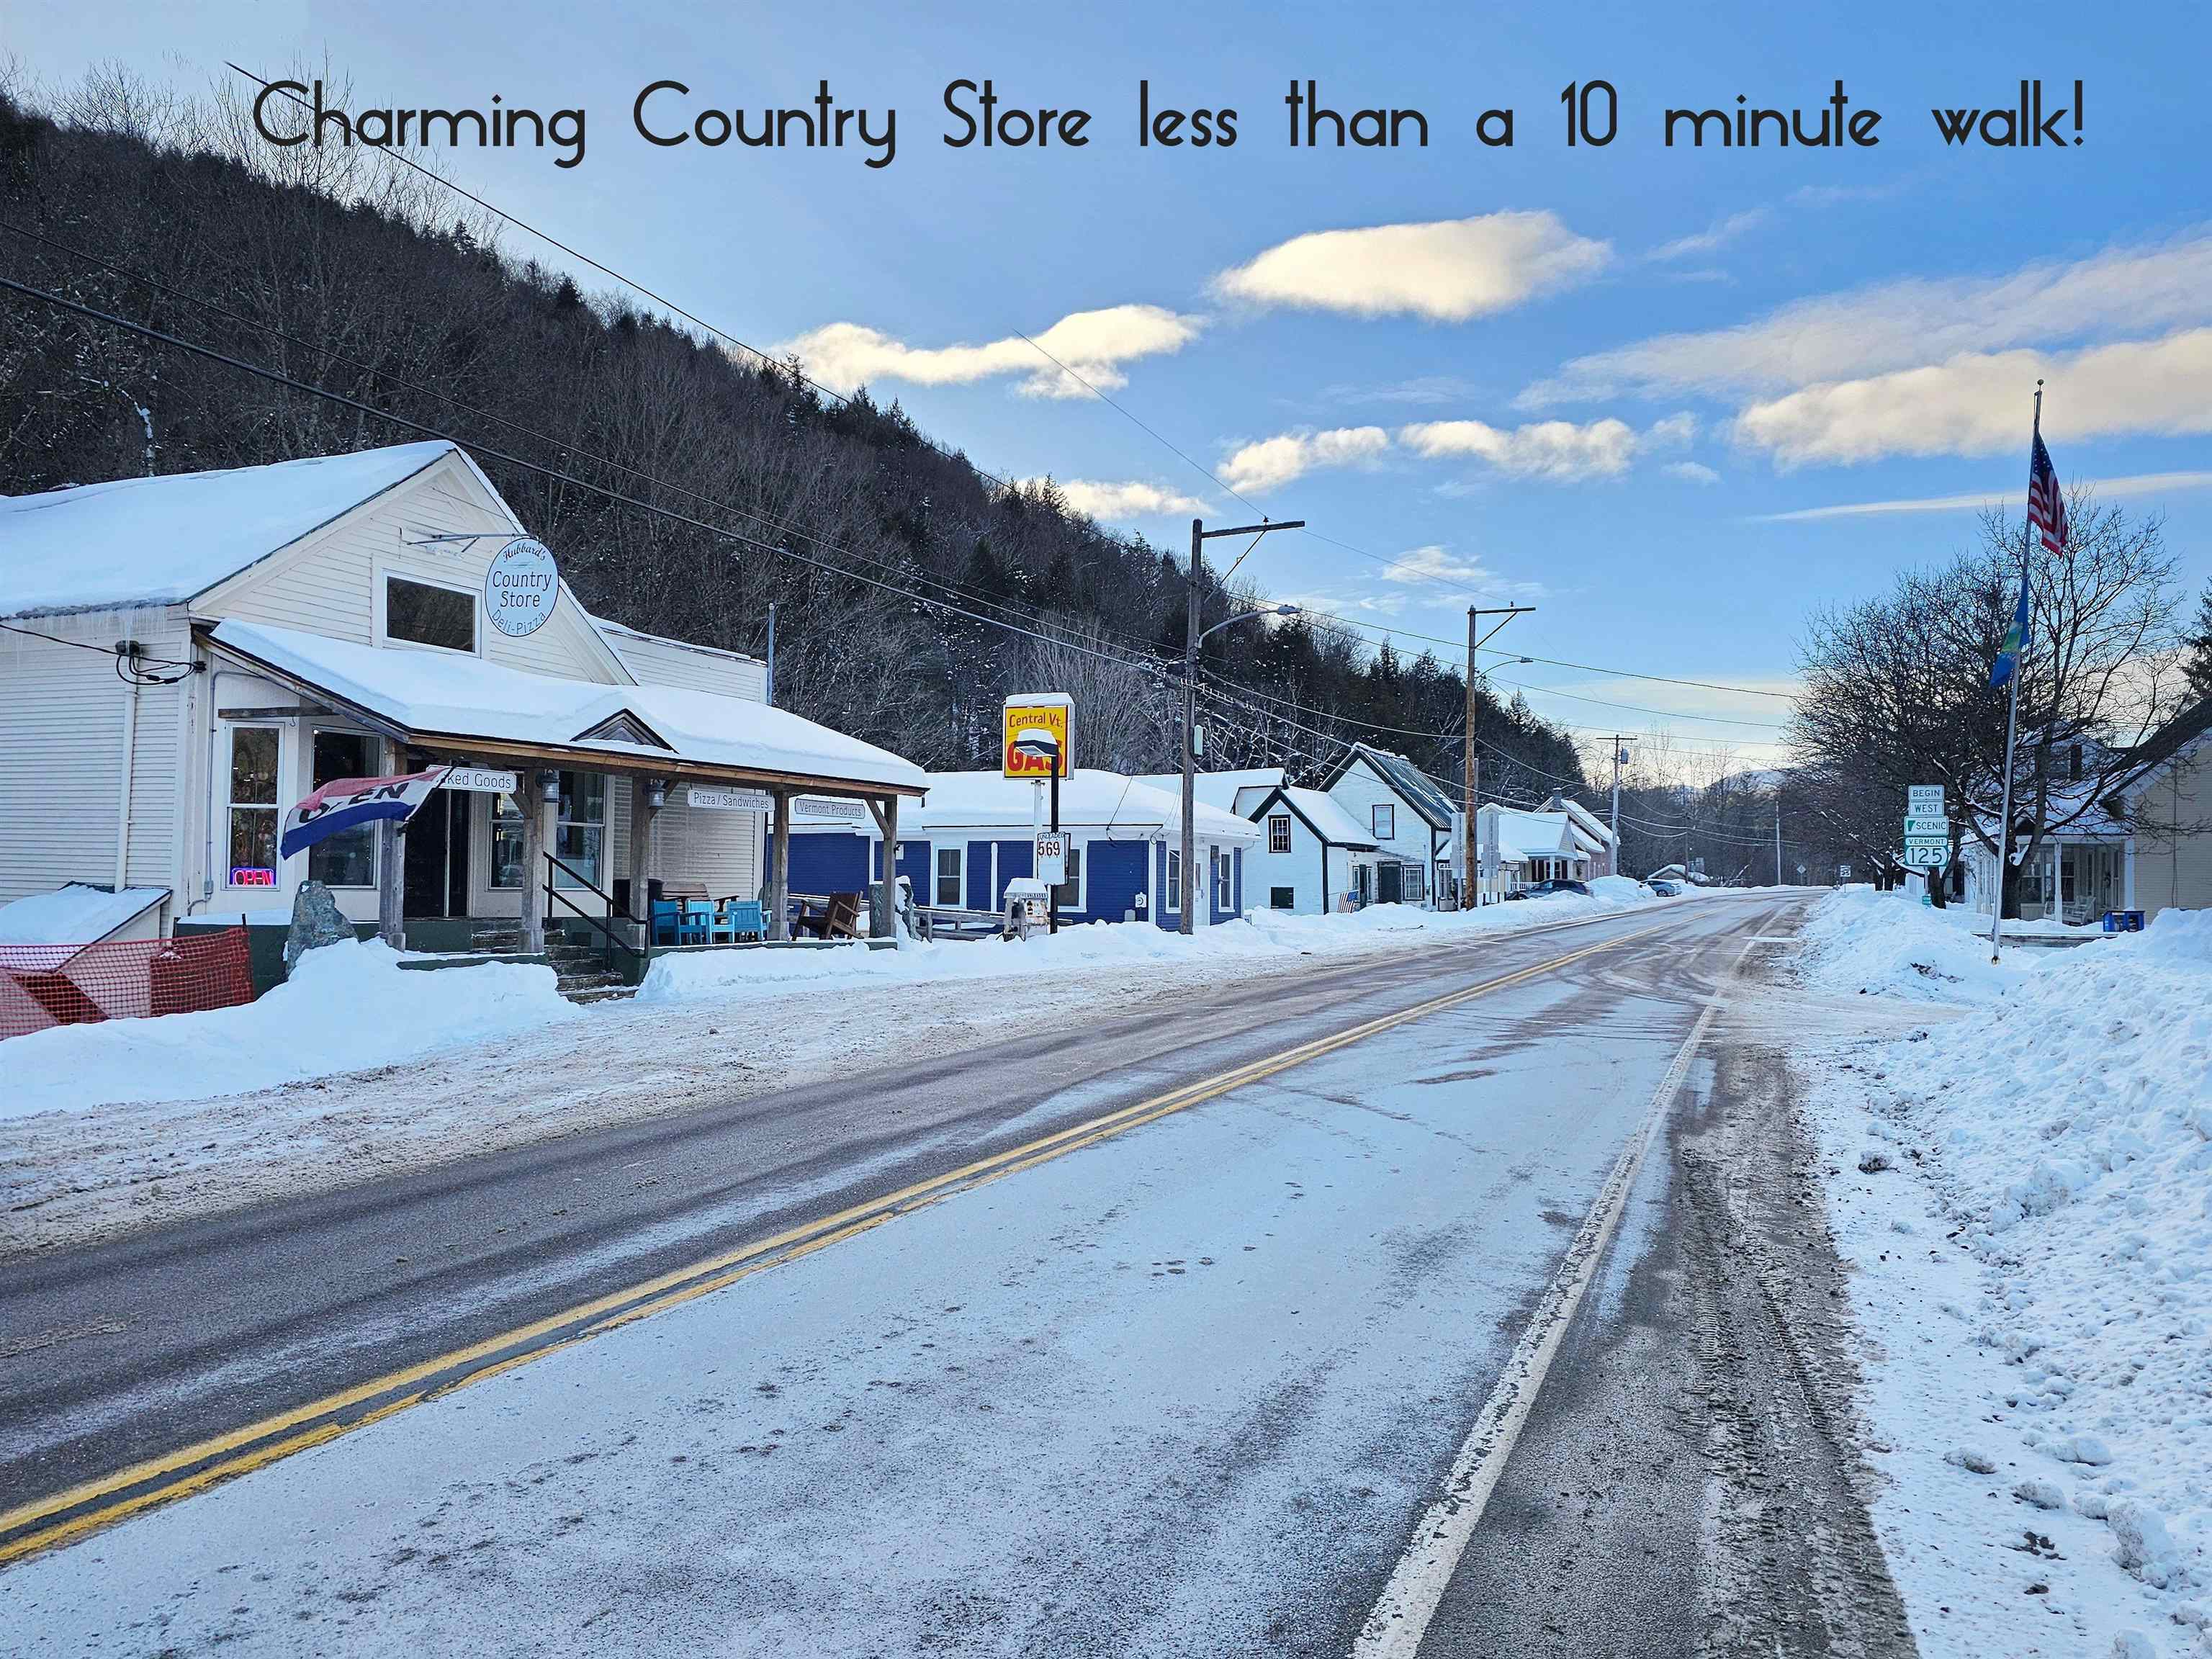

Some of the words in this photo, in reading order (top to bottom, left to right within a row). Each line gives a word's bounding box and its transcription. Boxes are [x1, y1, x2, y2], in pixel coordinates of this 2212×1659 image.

[503, 542, 545, 562] Hubbard's
[493, 571, 552, 592] Country
[500, 590, 540, 608] Store
[492, 609, 546, 634] Deli-Pizza
[1009, 711, 1046, 728] Central
[1048, 712, 1063, 728] Vt.
[475, 773, 511, 788] Goods
[299, 783, 409, 823] OEN
[693, 792, 716, 805] Pizza
[722, 794, 769, 809] Sandwiches
[799, 801, 830, 814] Vermont
[831, 804, 862, 817] Products
[1914, 804, 1938, 813] WEST
[1916, 822, 1946, 830] SCENIC
[1038, 841, 1061, 856] 569
[1910, 848, 1943, 864] 125
[234, 870, 272, 887] OPEN
